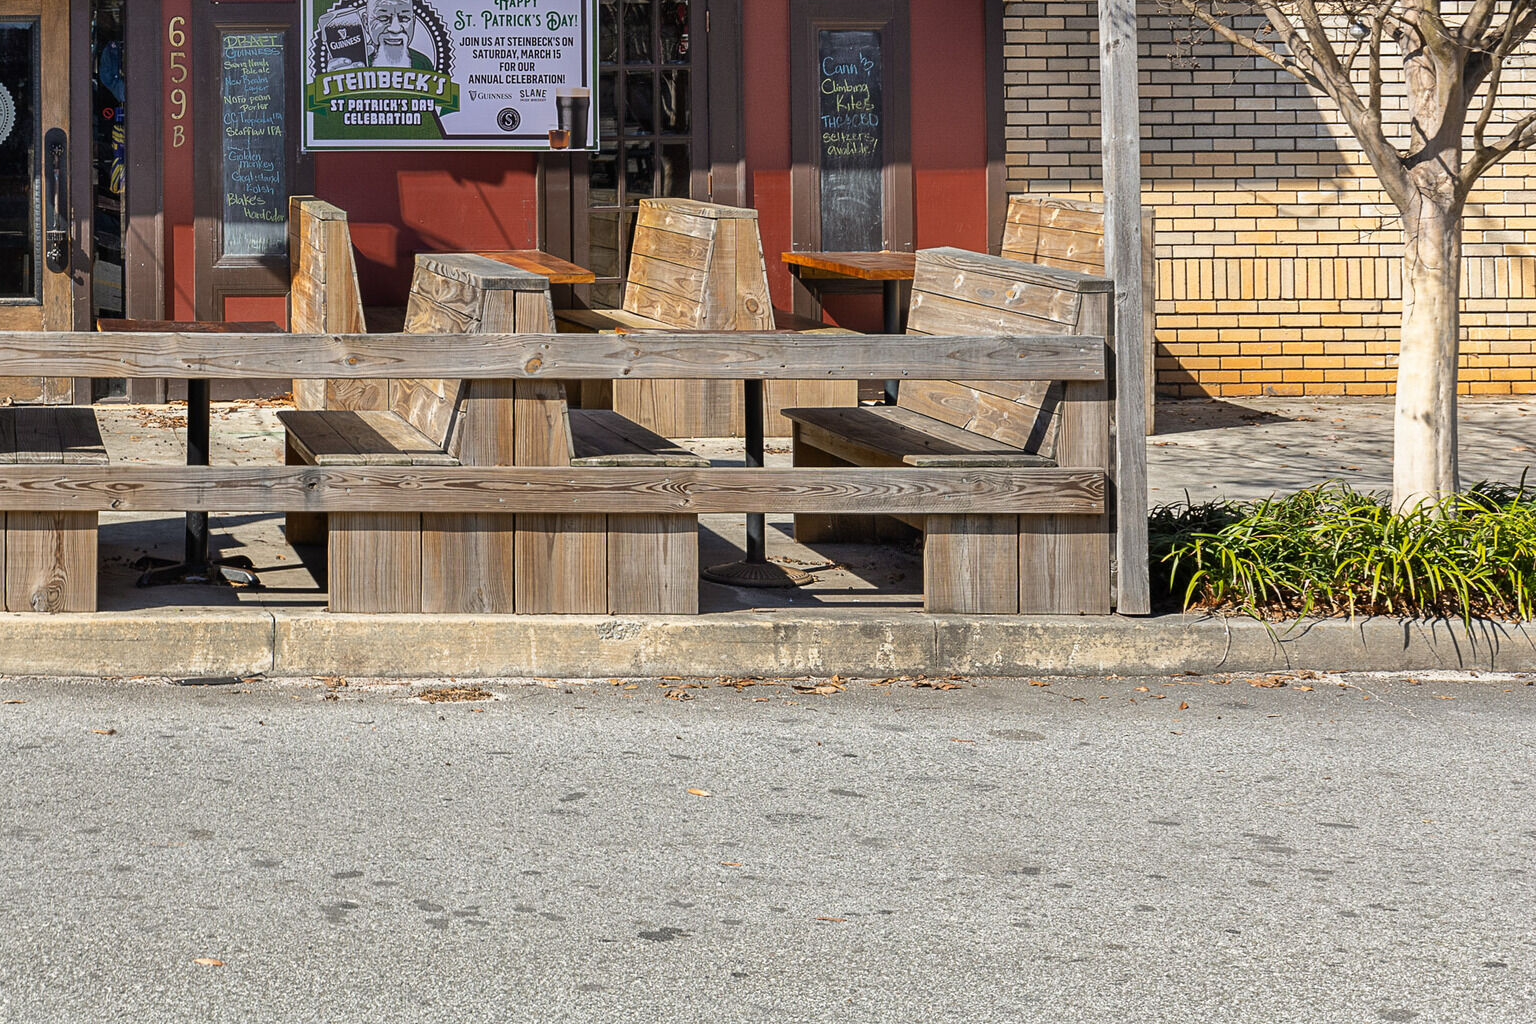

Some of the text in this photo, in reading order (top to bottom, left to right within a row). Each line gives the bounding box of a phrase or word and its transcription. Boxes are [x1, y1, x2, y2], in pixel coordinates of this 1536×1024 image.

[224, 36, 278, 46] DRAFT
[330, 36, 361, 50] GUINNESS
[460, 37, 573, 46] JOIN US AT STEINBECK'S ON
[473, 50, 561, 59] SATURDAY, MARCH 15
[500, 62, 535, 71] FOR OUR
[823, 57, 857, 76] Cann
[323, 71, 446, 95] STEINBECK'S
[468, 75, 565, 84] ANNUAL CELEBRATION!
[821, 78, 870, 100] Climbing
[478, 92, 512, 100] GUINNESS
[331, 99, 434, 111] ST PATRICK'S DAY
[837, 95, 874, 115] Kites
[344, 113, 421, 125] CELEBRATION
[268, 126, 281, 136] IPA
